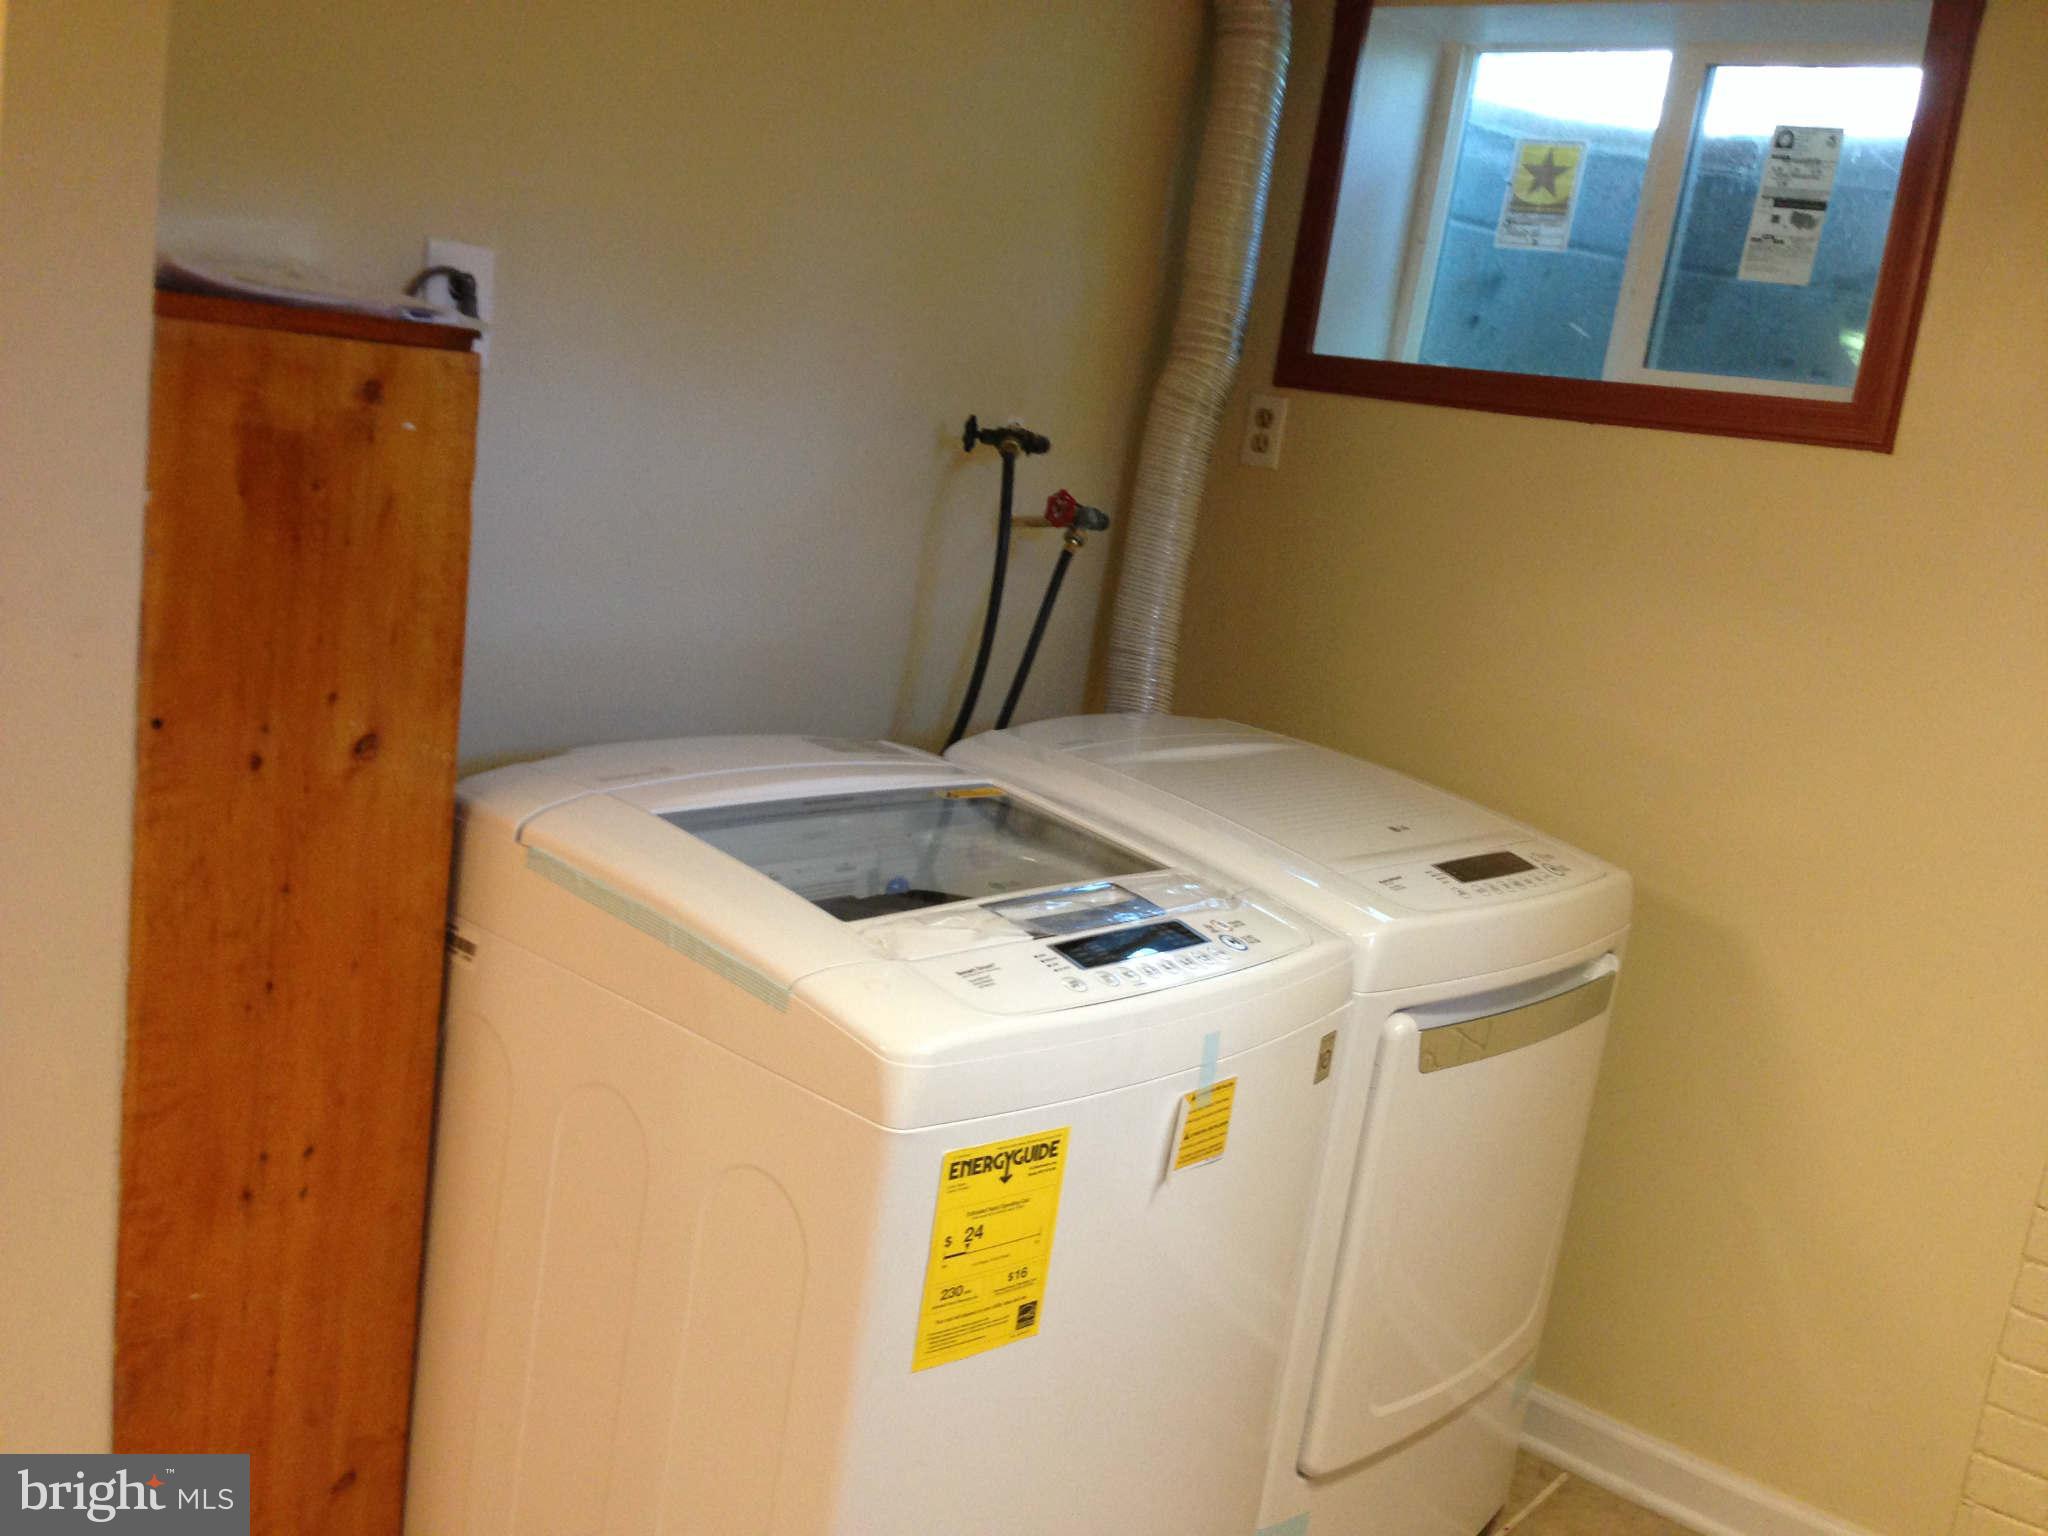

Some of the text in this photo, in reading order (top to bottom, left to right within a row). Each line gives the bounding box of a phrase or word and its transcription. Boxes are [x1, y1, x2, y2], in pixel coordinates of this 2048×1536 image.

[948, 1139, 1061, 1182] ENERGYGUIDE
[963, 1224, 985, 1243] 24
[1007, 1267, 1029, 1282] $16
[940, 1285, 965, 1301] 230
